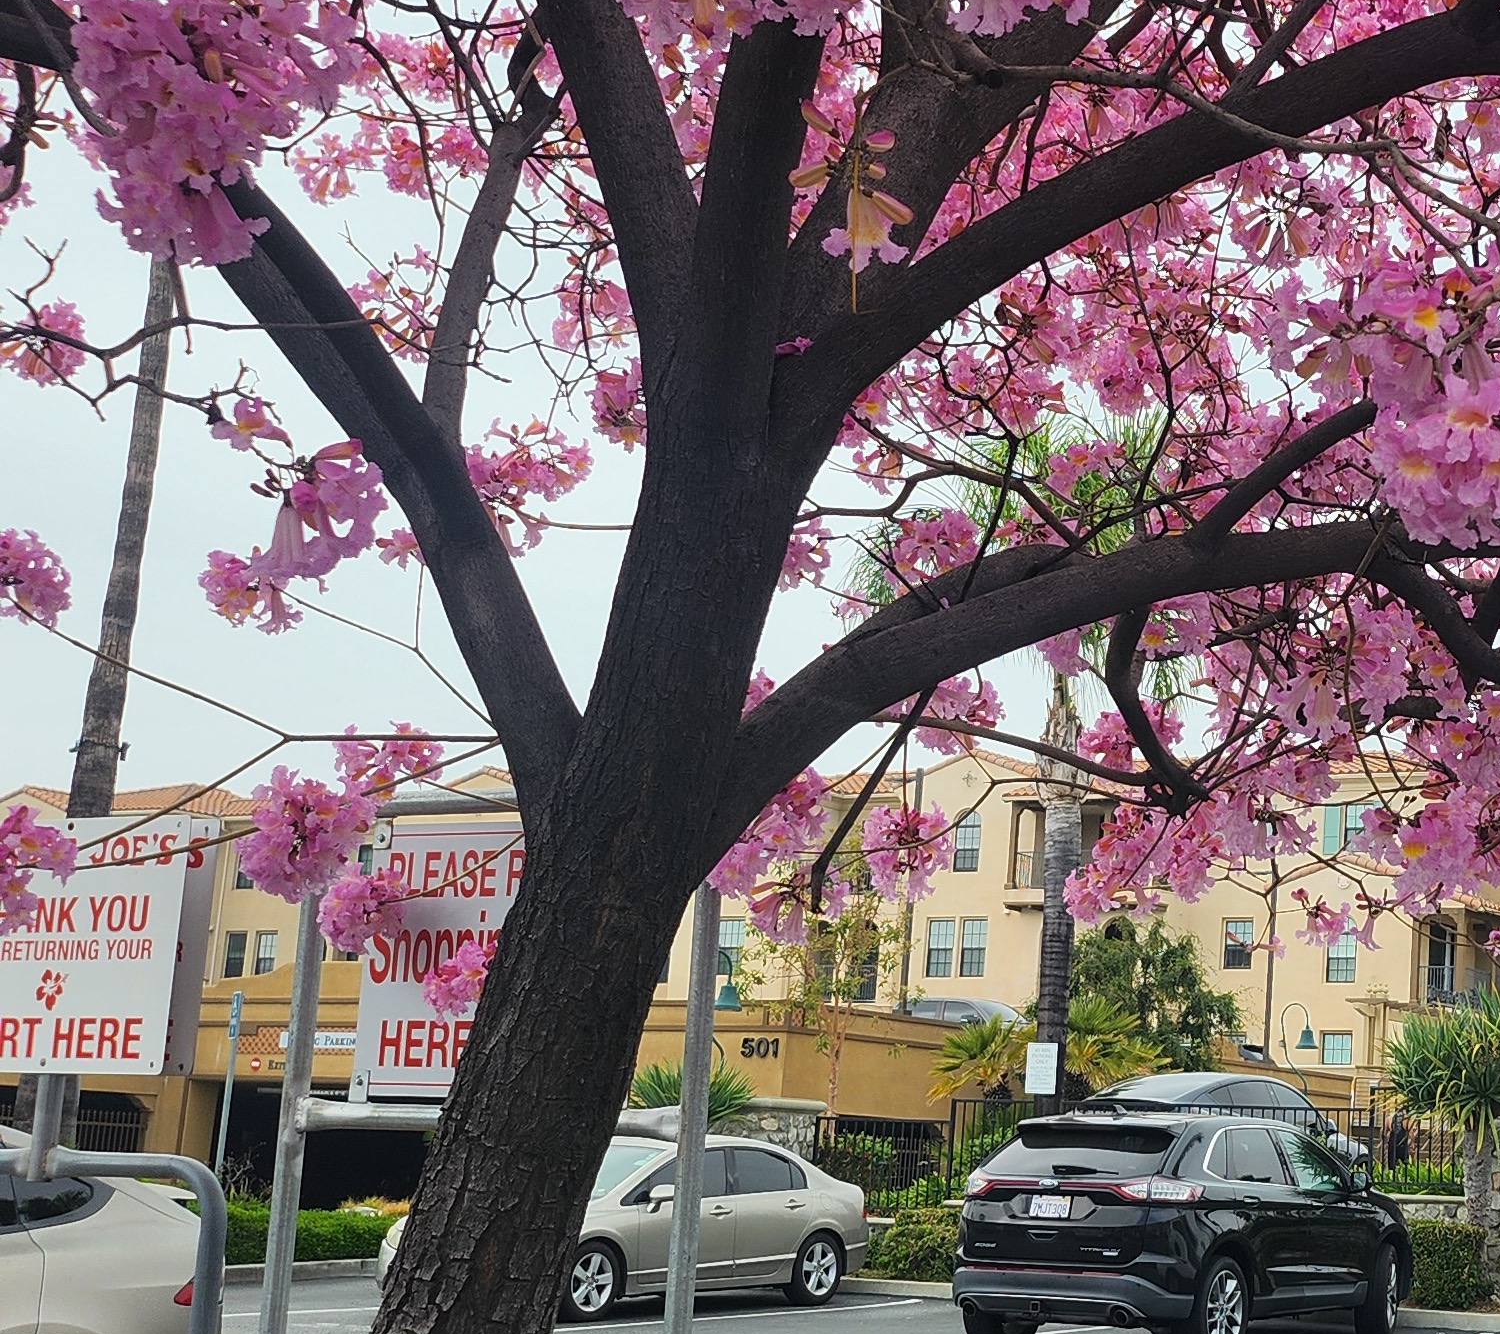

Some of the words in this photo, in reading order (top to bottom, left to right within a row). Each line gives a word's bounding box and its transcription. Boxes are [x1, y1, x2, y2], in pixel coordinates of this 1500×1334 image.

[88, 833, 180, 866] JOE'S
[389, 849, 497, 898] PLEASE
[89, 895, 150, 932] YOU
[1, 940, 100, 961] RETURNING
[106, 938, 153, 960] YOUR
[51, 1017, 143, 1059] HERE
[323, 1035, 357, 1046] PARKIN
[740, 1037, 780, 1059] 501
